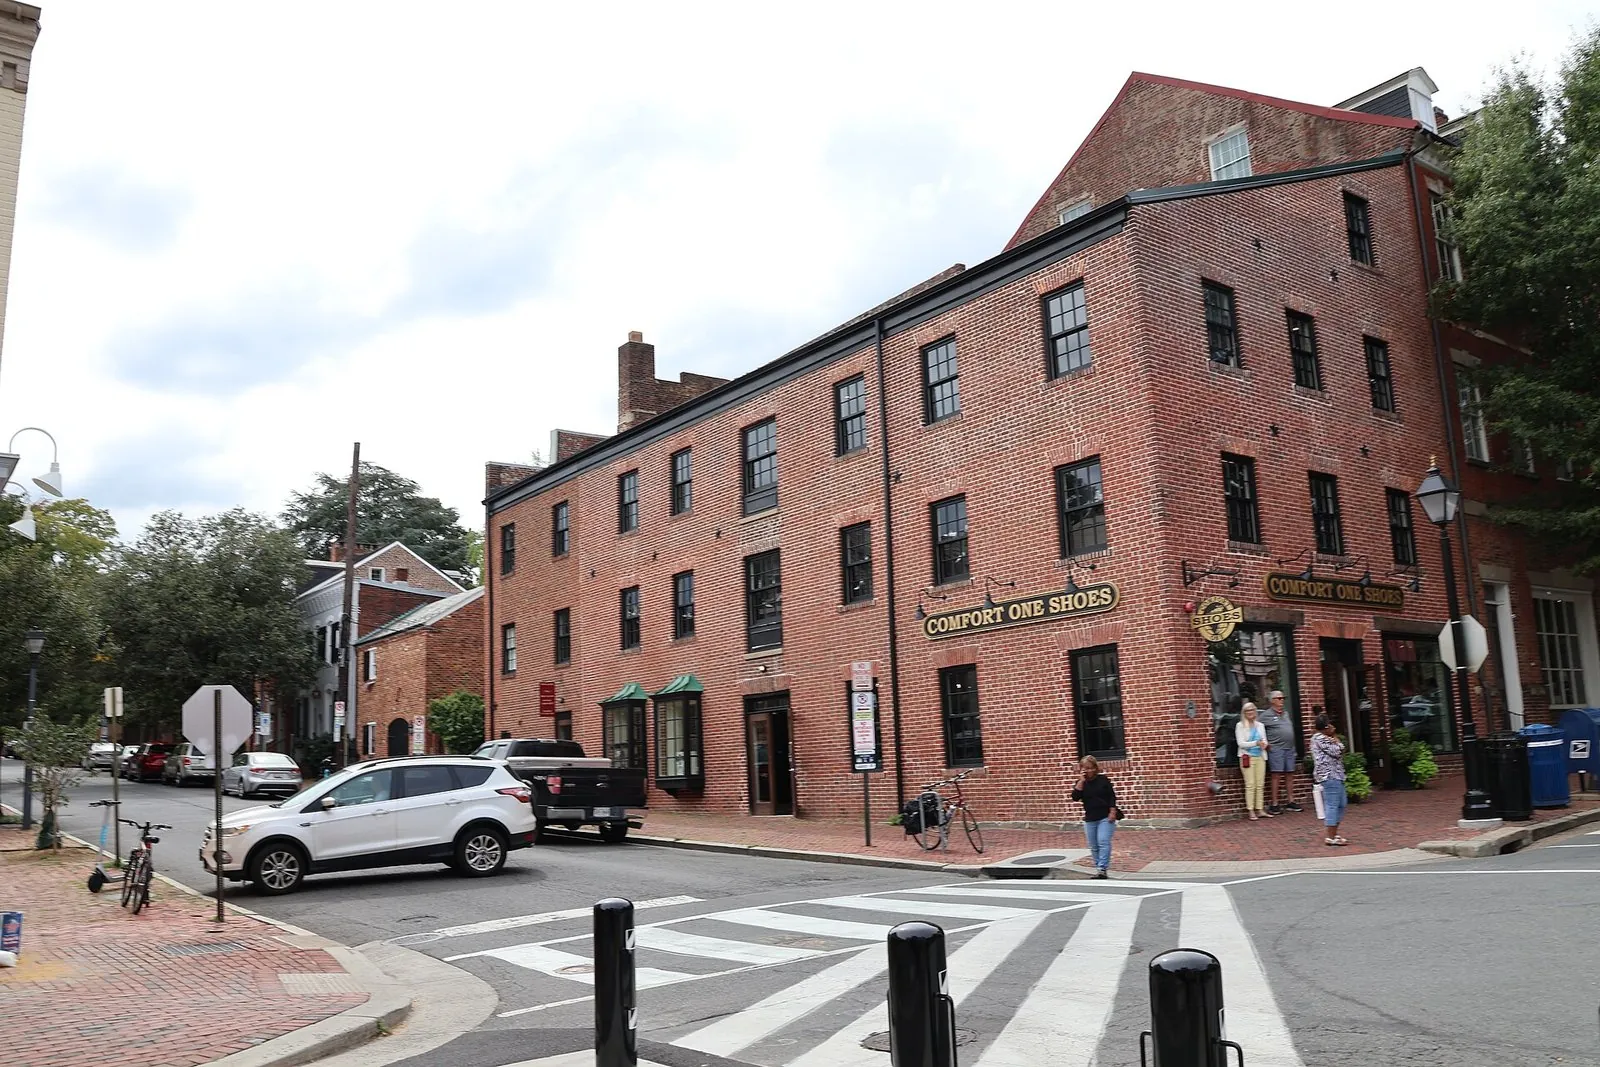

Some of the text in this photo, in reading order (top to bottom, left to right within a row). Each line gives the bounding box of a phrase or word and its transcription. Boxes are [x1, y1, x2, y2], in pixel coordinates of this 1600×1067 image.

[1270, 577, 1402, 605] COMFORT ONE SHOES
[927, 587, 1113, 634] COMFORT ONE SHOES
[1192, 611, 1240, 626] SHOES
